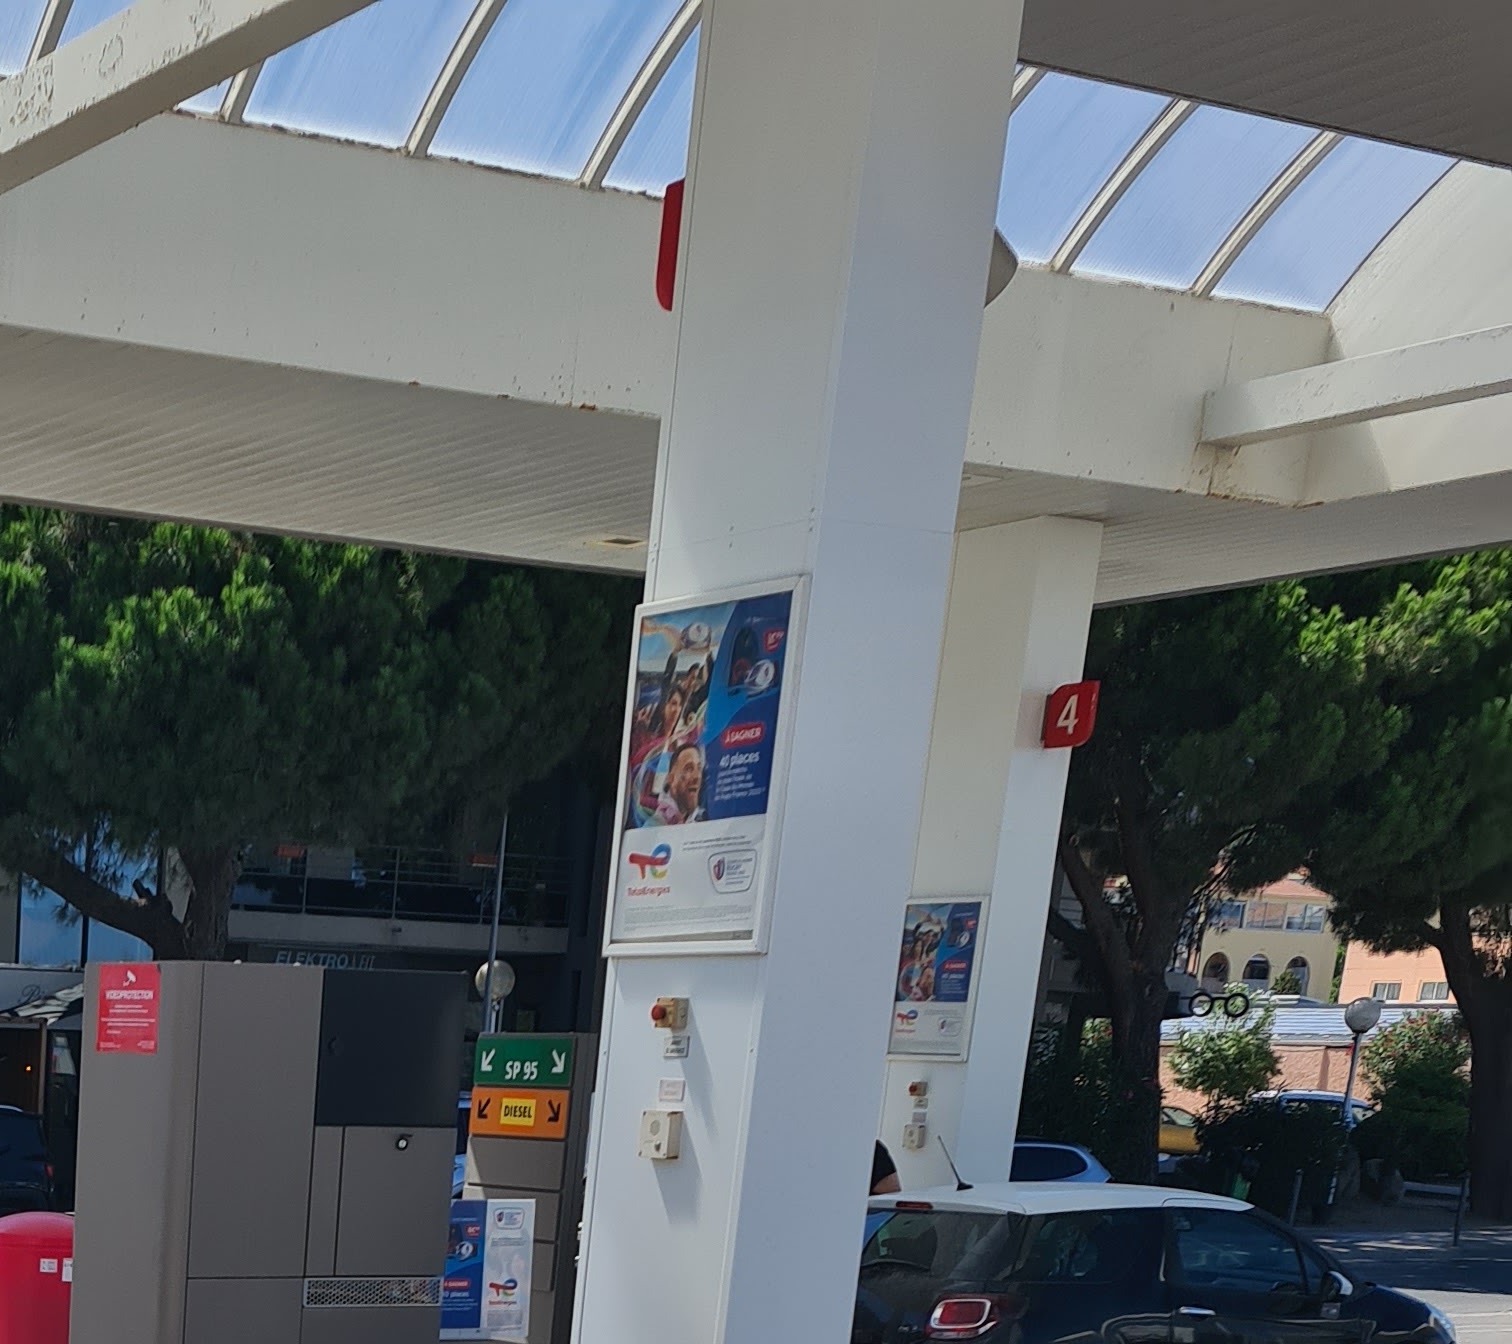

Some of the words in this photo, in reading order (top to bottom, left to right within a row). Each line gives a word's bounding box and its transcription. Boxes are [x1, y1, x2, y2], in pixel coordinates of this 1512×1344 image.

[1055, 694, 1080, 736] 4
[504, 1060, 521, 1080] SP
[522, 1060, 538, 1080] 95
[503, 1105, 532, 1119] DIESEL
